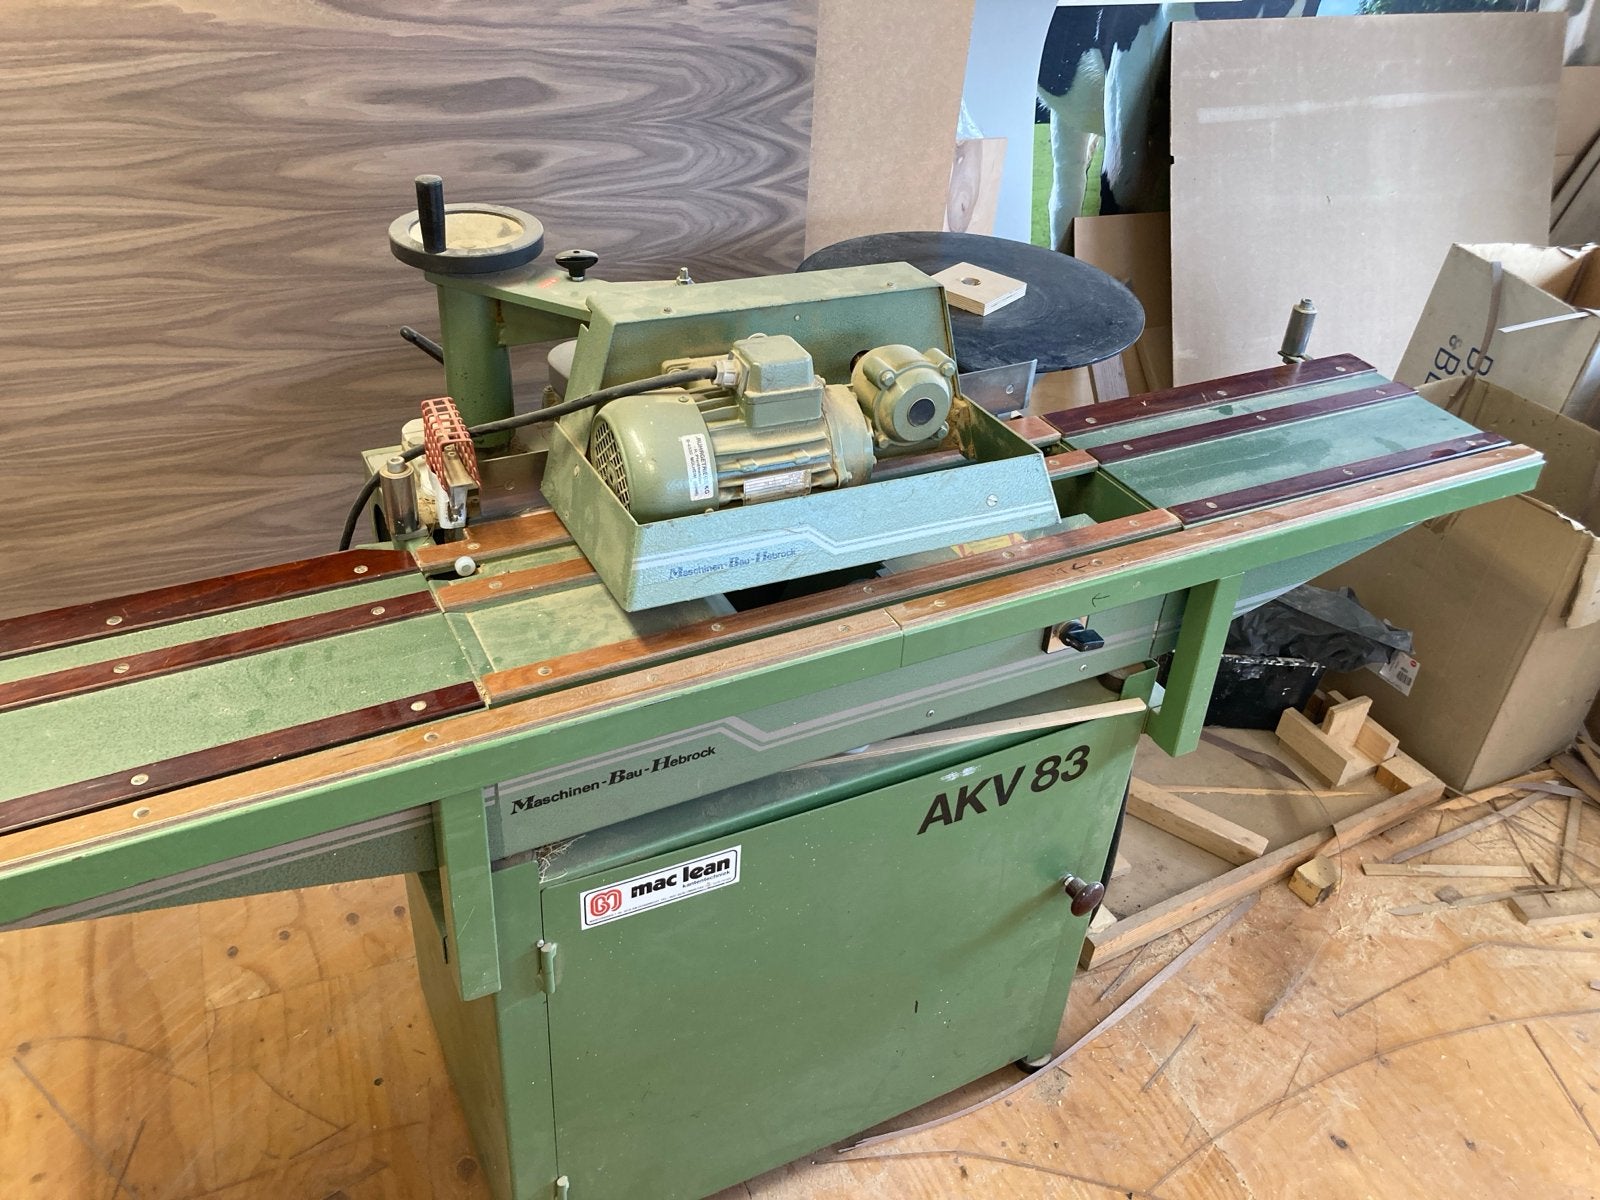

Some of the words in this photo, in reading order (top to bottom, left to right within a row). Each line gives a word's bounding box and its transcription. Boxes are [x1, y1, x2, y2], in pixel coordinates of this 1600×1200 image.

[1461, 347, 1494, 376] B
[917, 765, 1026, 835] AKV
[1030, 745, 1091, 793] 83
[631, 873, 677, 899] mac
[682, 858, 730, 883] lean
